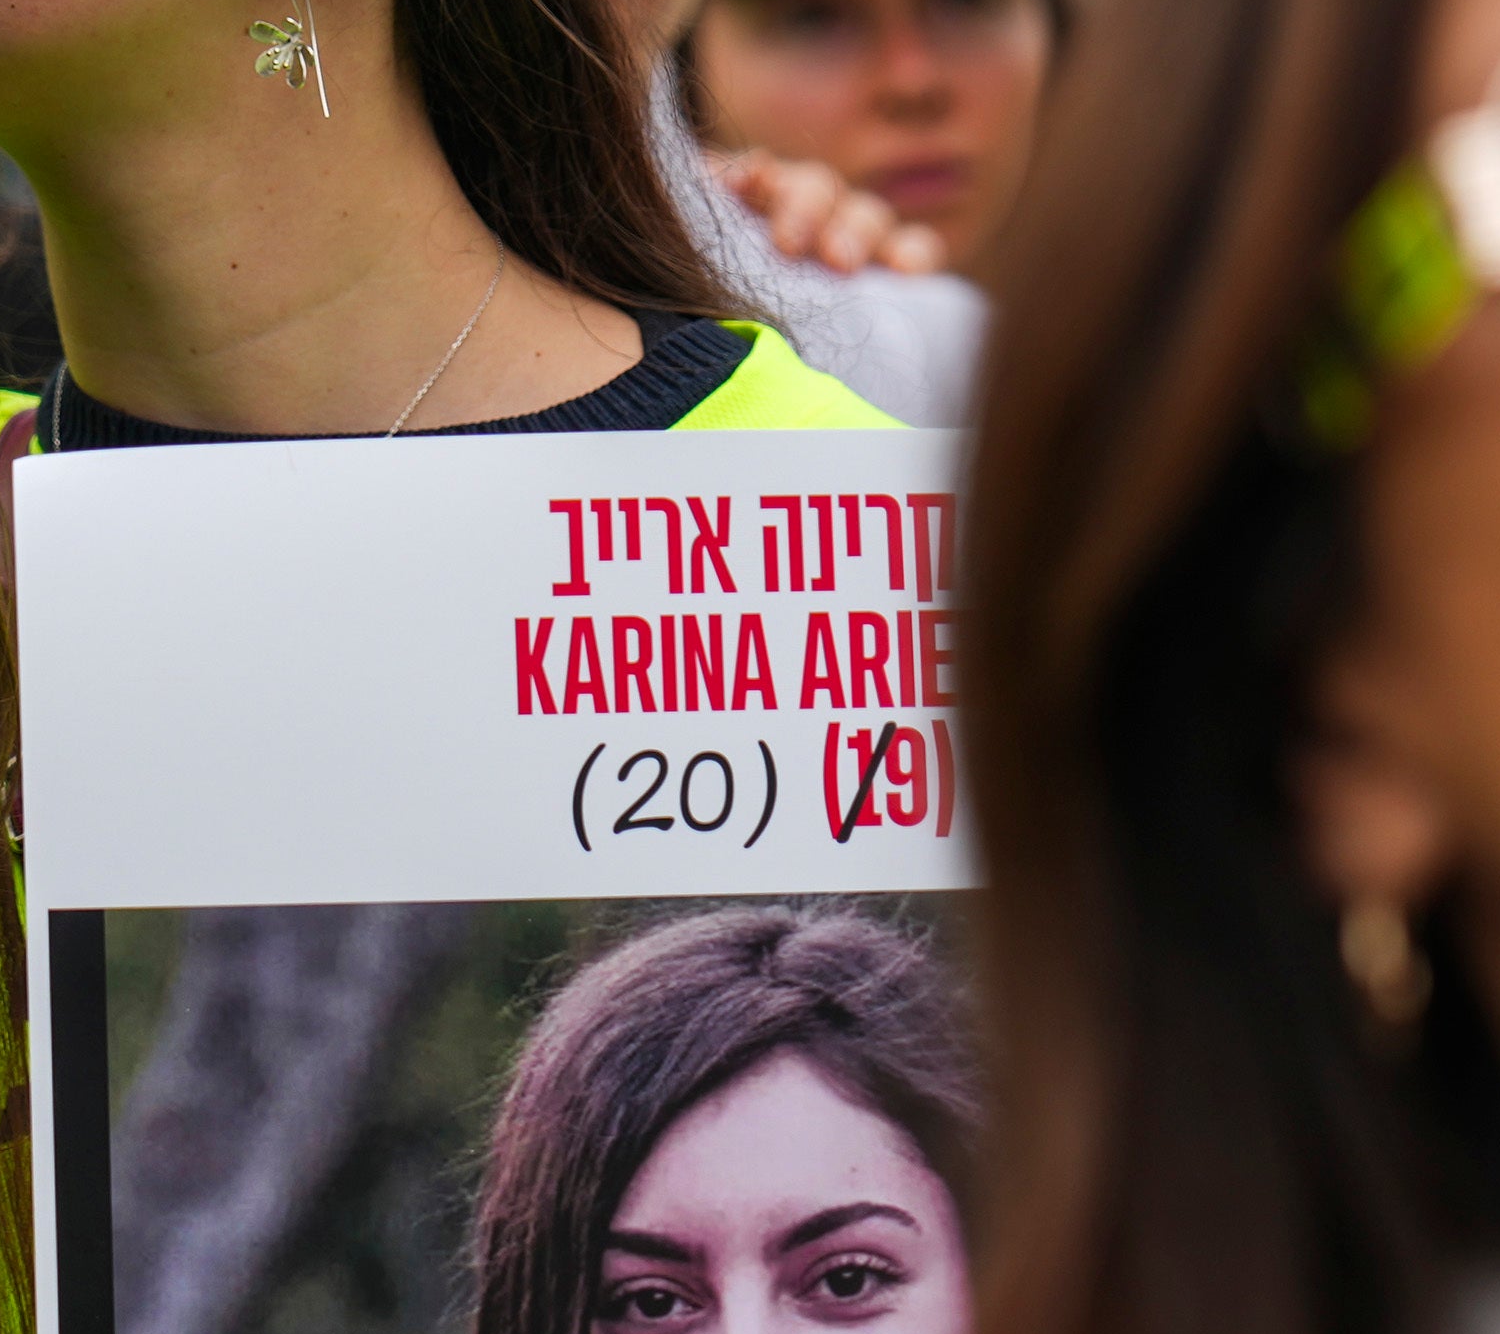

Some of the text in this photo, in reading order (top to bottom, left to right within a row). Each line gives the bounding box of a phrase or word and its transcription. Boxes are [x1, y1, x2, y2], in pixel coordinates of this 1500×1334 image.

[548, 495, 738, 597] ארייב
[514, 609, 962, 716] KARINA ARIE
[572, 739, 778, 853] (20)
